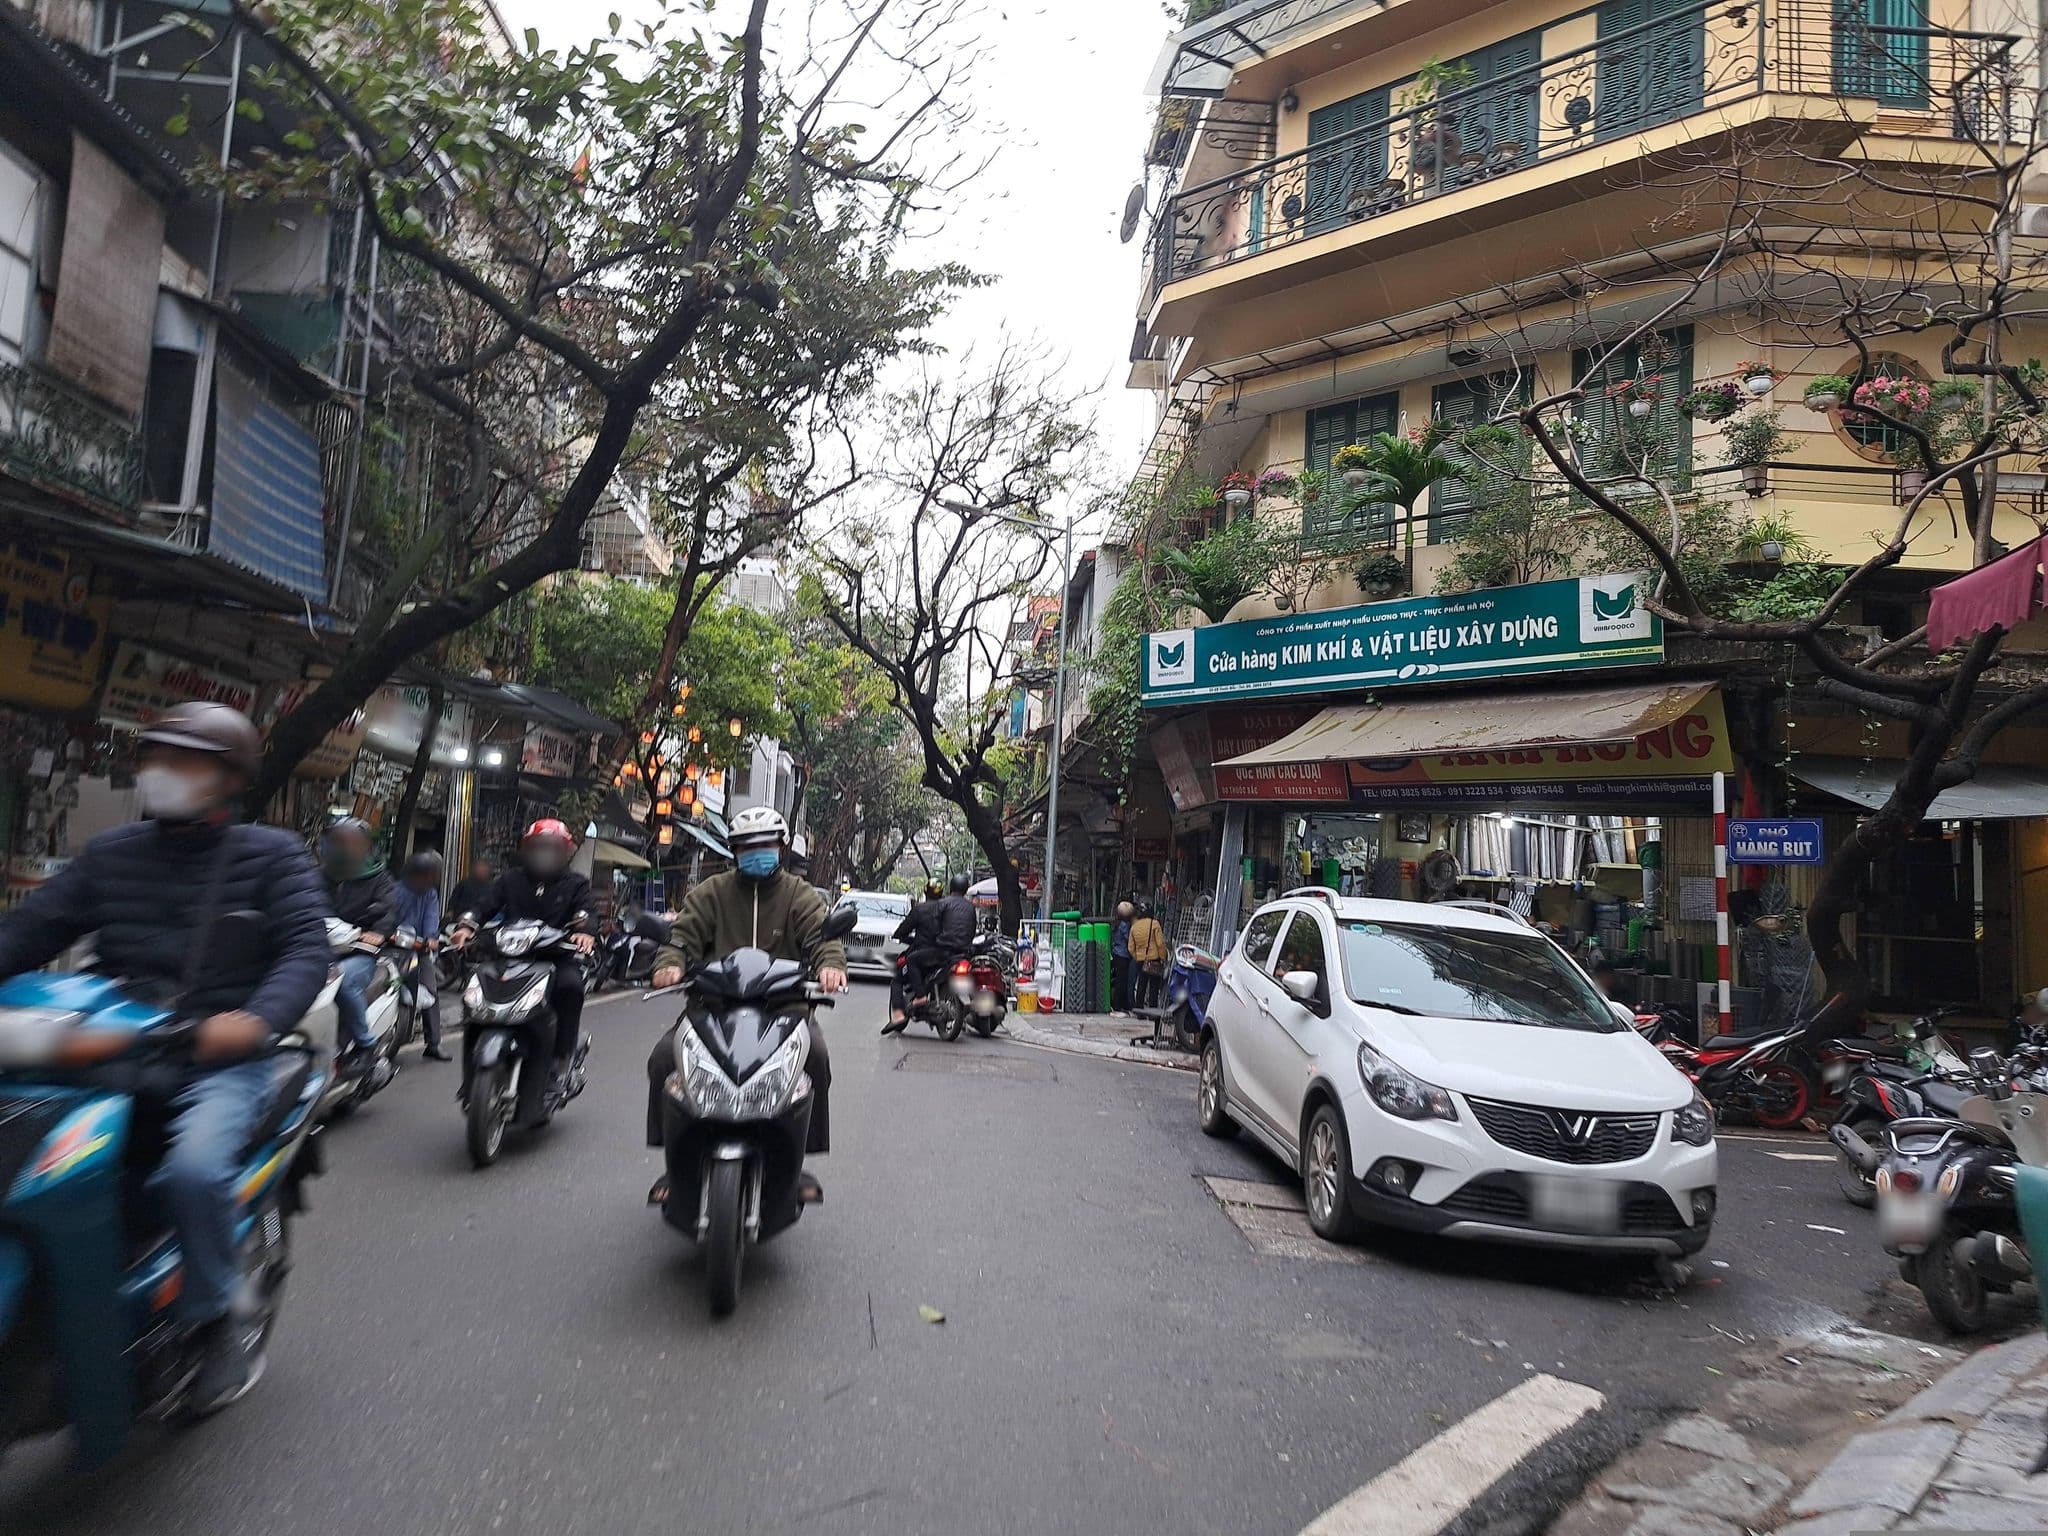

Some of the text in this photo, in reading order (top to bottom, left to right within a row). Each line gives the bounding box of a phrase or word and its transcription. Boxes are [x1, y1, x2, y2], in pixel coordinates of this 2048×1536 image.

[1256, 628, 1275, 636] CÔNG
[1285, 624, 1294, 633] CỔ
[1315, 620, 1331, 630] XUẤT
[1333, 618, 1351, 629] NHẬP
[1372, 613, 1398, 623] LƯƠNG
[1400, 610, 1417, 621] THỰC
[1424, 607, 1442, 618] THỰC
[1467, 602, 1477, 611] HÀ
[1479, 601, 1494, 611] NỘI
[1209, 615, 1559, 673] Cửa hàng KIM KHÍ & VẬT LIỆU XÂY DỰNG
[1361, 788, 1378, 797] TEL:
[1380, 788, 1399, 798] (024)
[1400, 788, 1420, 797] 3825
[1448, 787, 1463, 796] 091
[1464, 786, 1486, 795] 3223
[1487, 786, 1504, 794] 534
[1510, 784, 1565, 794] 0934475448
[1577, 783, 1606, 792] Email:
[1758, 825, 1789, 837] PHỐ
[1736, 838, 1780, 857] HÀNG
